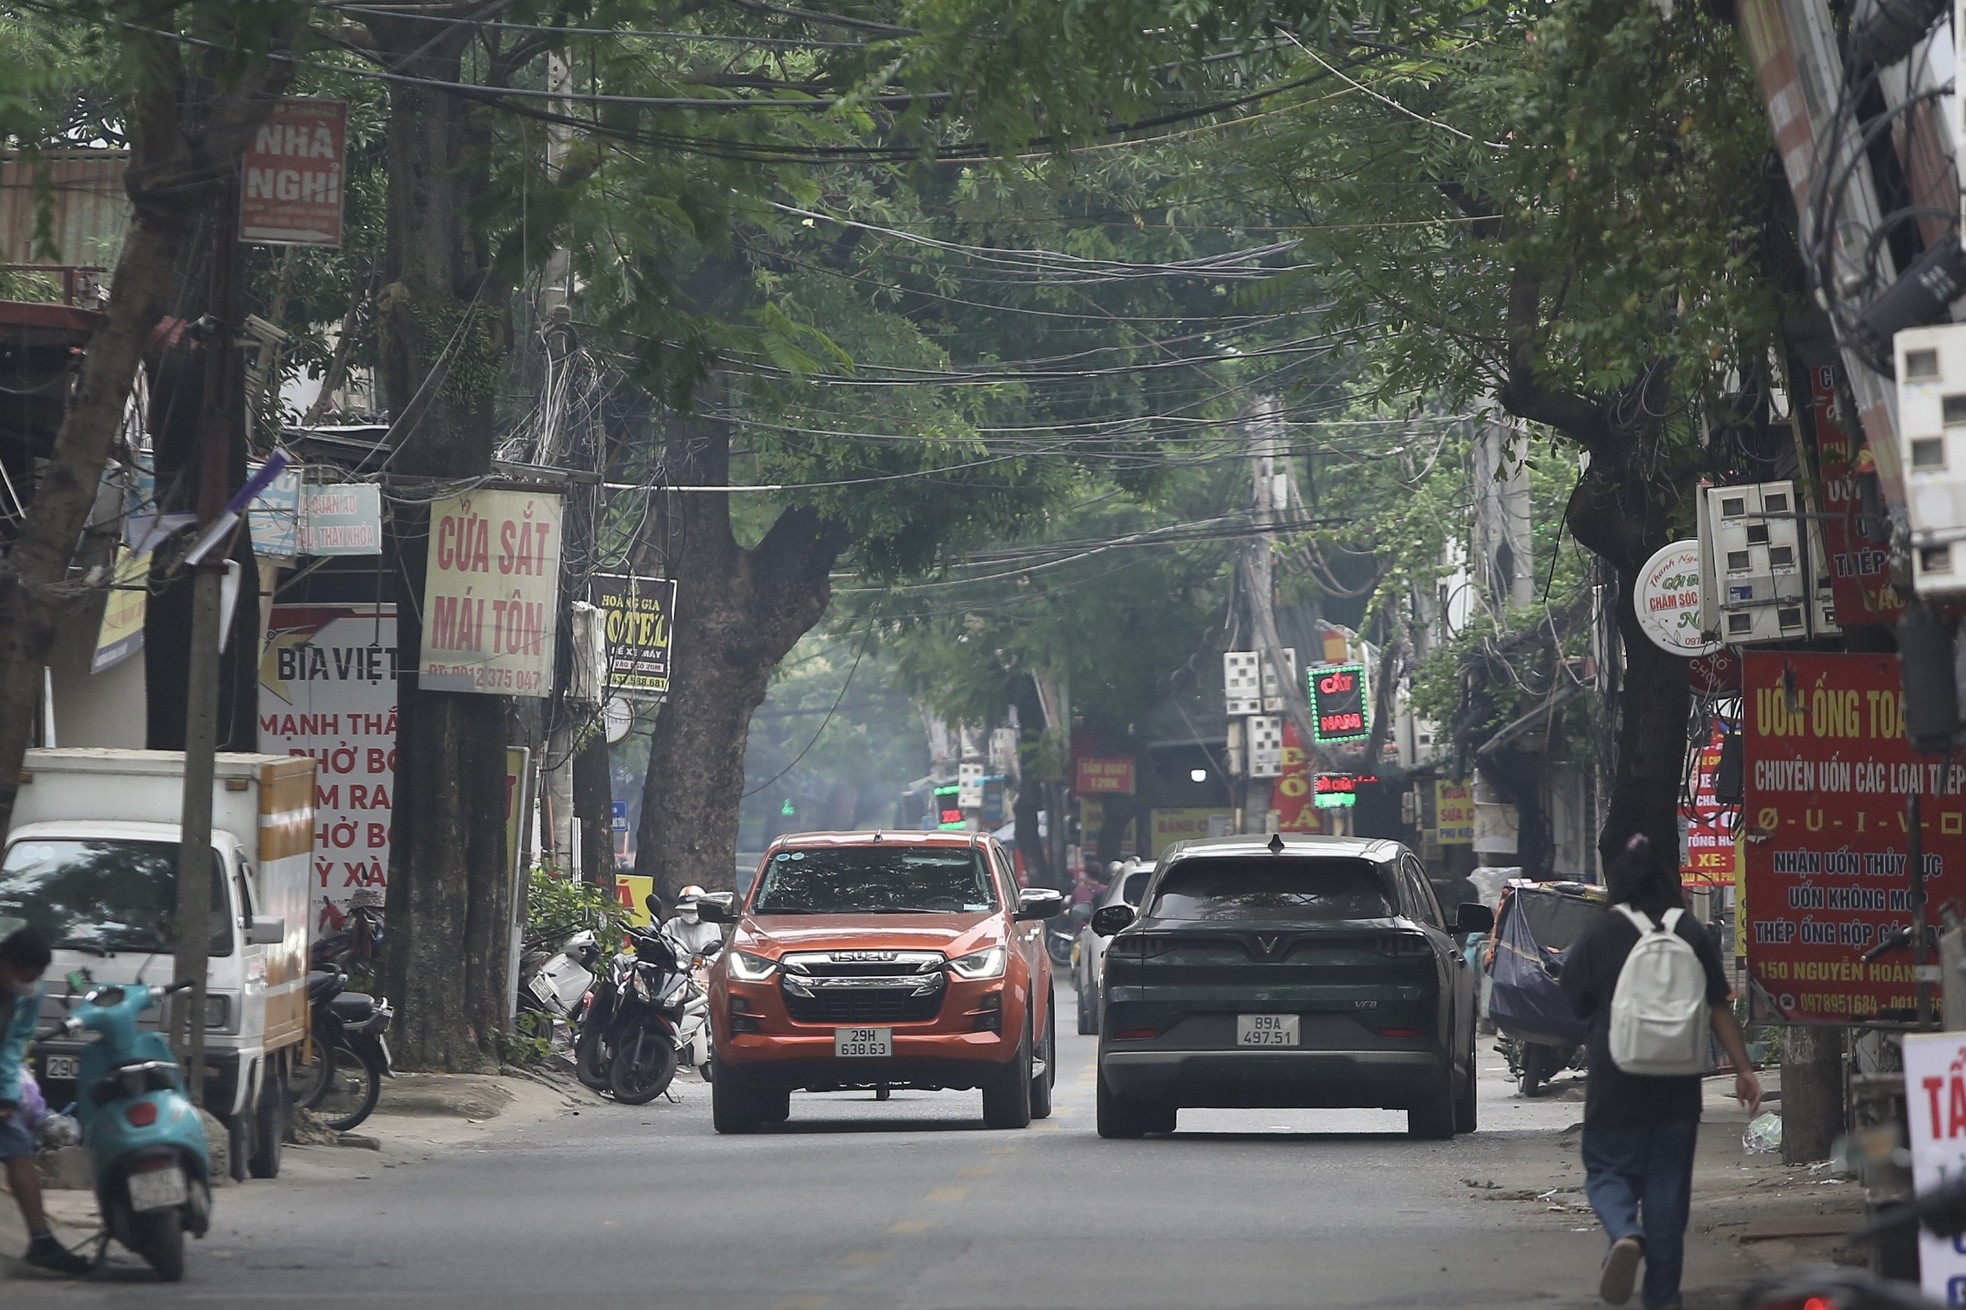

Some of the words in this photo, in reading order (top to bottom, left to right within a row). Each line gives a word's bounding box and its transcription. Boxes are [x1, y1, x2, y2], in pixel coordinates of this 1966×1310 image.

[256, 121, 334, 158] NHÀ
[247, 162, 340, 203] NGHỈ
[437, 498, 489, 573] CỬA
[498, 501, 550, 576] SẮT
[1650, 559, 1675, 588] Thanh
[1662, 574, 1685, 591] GỘI
[602, 593, 639, 609] HOÀNG
[642, 598, 660, 611] GIA
[1650, 593, 1677, 611] CHĂM
[1679, 590, 1698, 608] SÓC
[432, 586, 484, 652] MÁI
[493, 589, 543, 656] TÔN
[605, 610, 668, 648] OTEL
[278, 647, 329, 681] BIA
[332, 641, 397, 685] VIỆT
[488, 668, 513, 689] 375
[516, 670, 541, 690] 047
[1757, 670, 1804, 738] UỐN
[1812, 672, 1860, 738] ỐNG
[260, 713, 339, 741] MẠNH
[1321, 713, 1361, 732] NAM
[1755, 754, 1815, 791] CHUYÊN
[1819, 751, 1850, 792] UỐN
[1855, 757, 1886, 793] CÁC
[1774, 848, 1820, 878] NHẬN
[1825, 846, 1860, 875] UỐN
[1865, 847, 1906, 876] THỦY
[1920, 853, 1943, 881] ỰC
[1789, 880, 1823, 909] UỐN
[1828, 883, 1885, 910] KHÔNG
[1754, 917, 1796, 944] THÉP
[1801, 915, 1836, 944] ỐNG
[1839, 919, 1874, 949] HỘP
[834, 952, 892, 961] ISUZU
[1759, 961, 1788, 979] 150
[1794, 955, 1863, 981] NGUYỄN
[1800, 993, 1878, 1014] 0978951684
[851, 1030, 876, 1042] 29H
[1255, 1017, 1281, 1030] 89A
[841, 1043, 886, 1056] 638.63
[1244, 1031, 1291, 1045] 497.51
